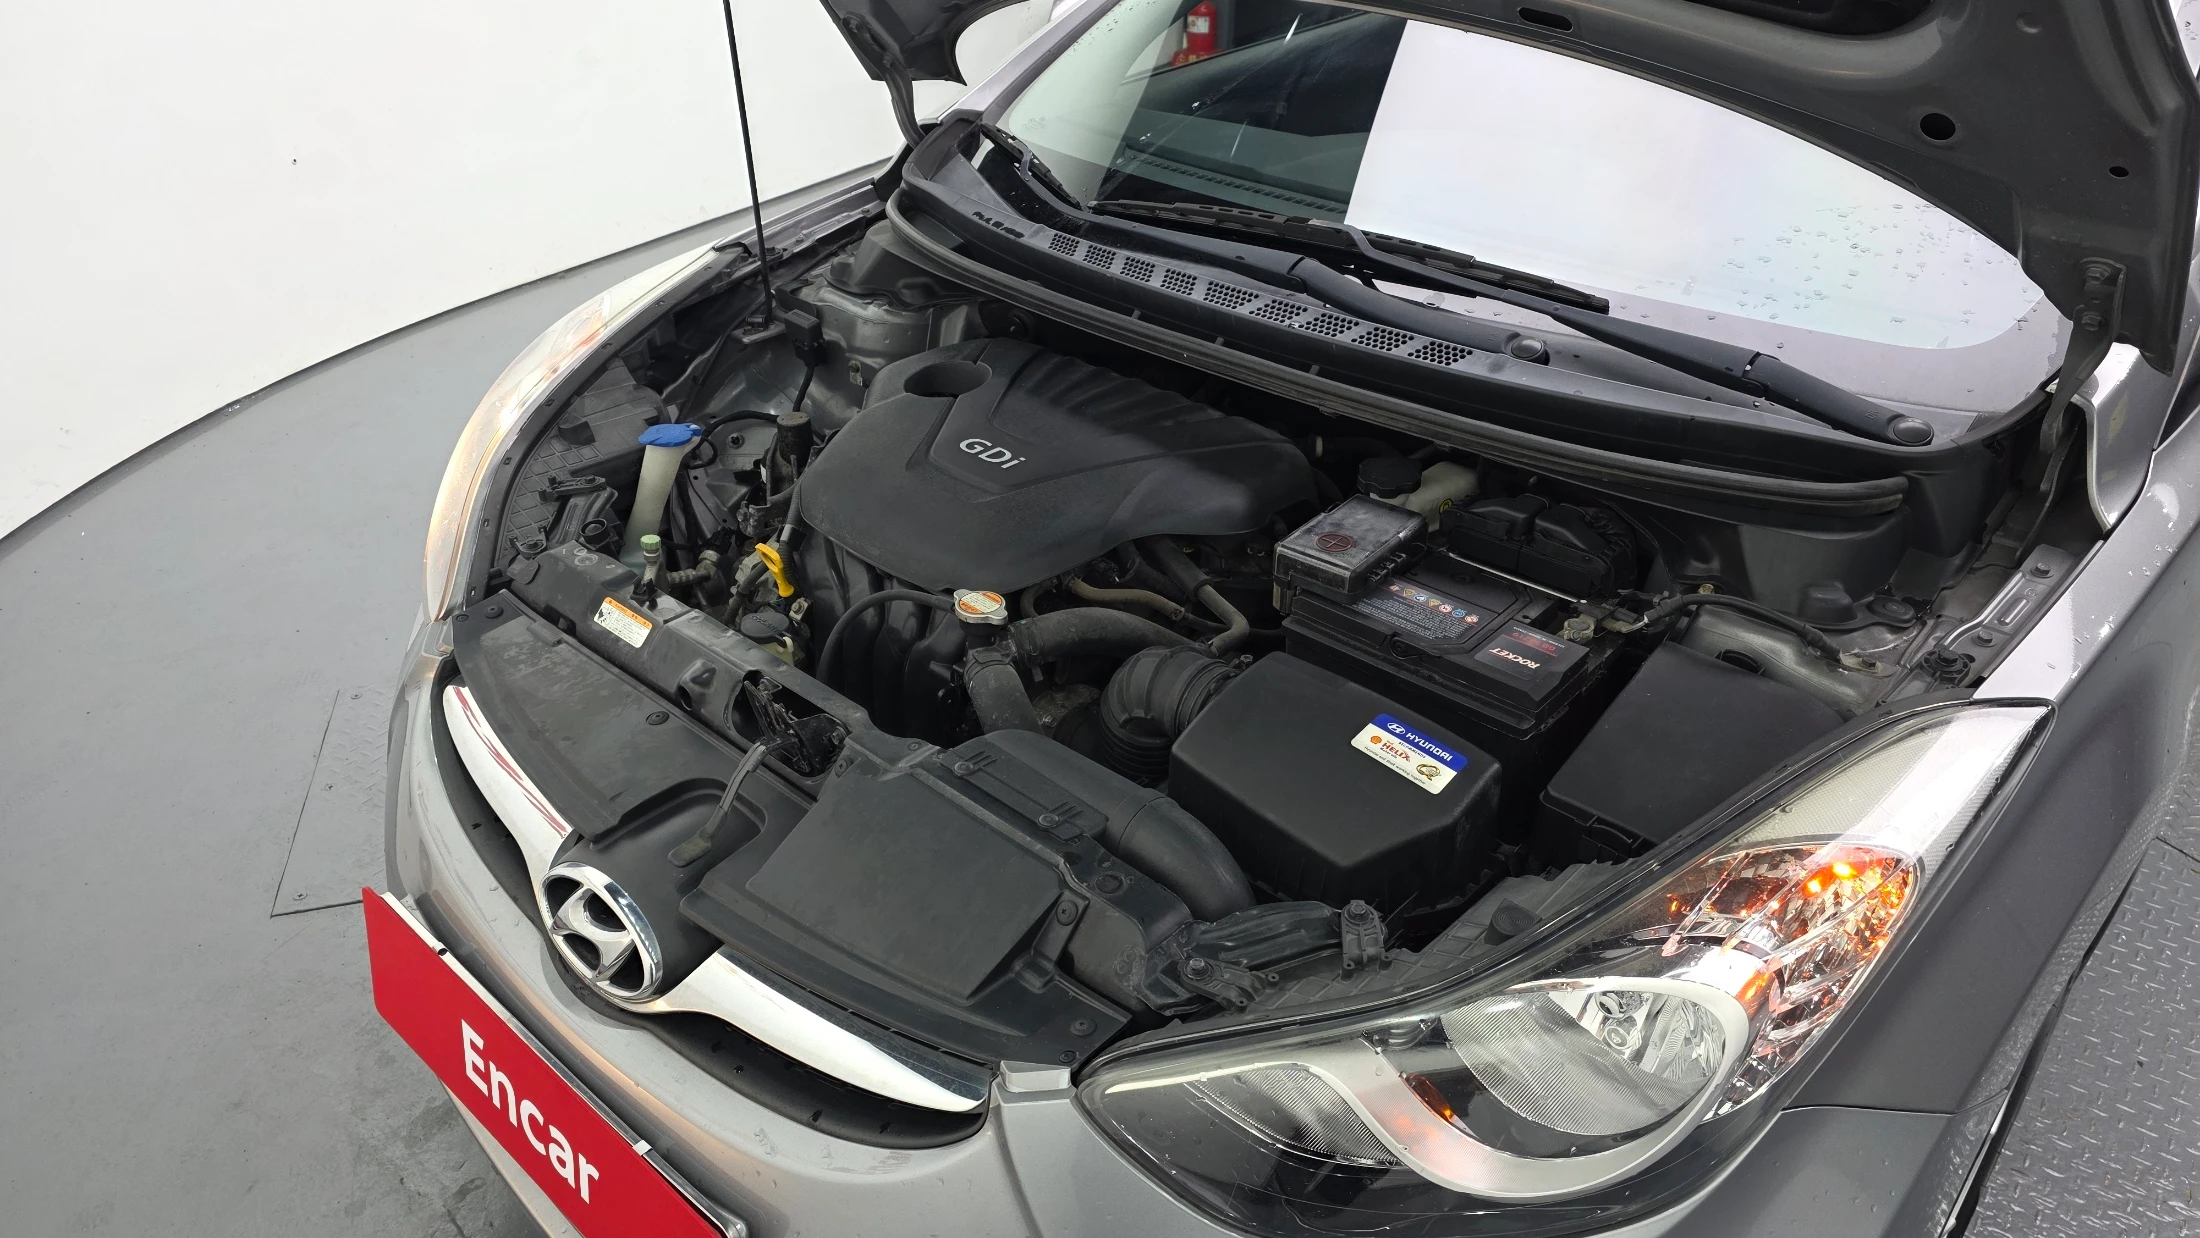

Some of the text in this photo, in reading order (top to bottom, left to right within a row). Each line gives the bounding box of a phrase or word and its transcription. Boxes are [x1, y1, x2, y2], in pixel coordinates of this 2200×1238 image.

[960, 438, 1026, 469] GDi
[1489, 647, 1540, 669] ROCKET
[1382, 742, 1410, 761] HELIX
[1405, 732, 1454, 762] HYUNDAI
[461, 1018, 600, 1205] Encar
